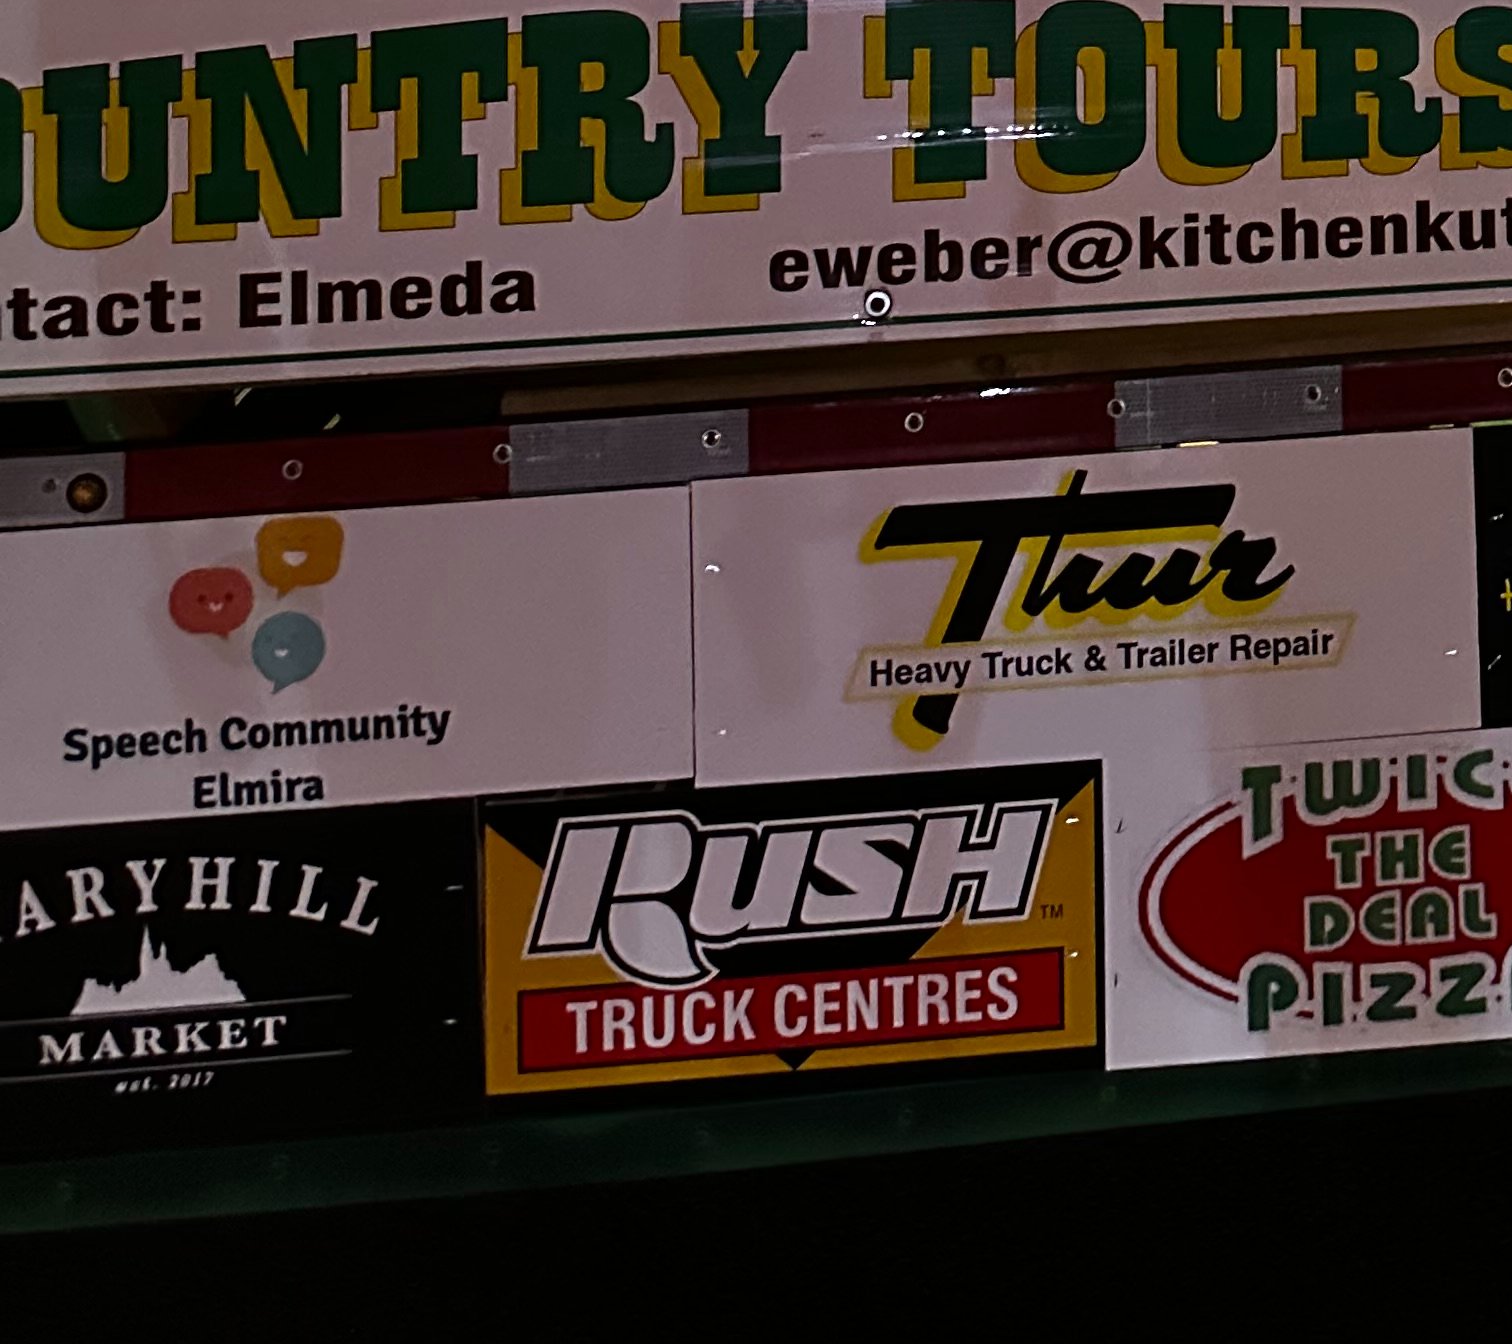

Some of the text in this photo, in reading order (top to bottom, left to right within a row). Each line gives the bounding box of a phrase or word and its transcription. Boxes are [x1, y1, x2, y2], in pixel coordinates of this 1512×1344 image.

[0, 0, 808, 250] UNTRY
[0, 261, 536, 341] tact: Elmeda
[857, 469, 1295, 752] Thur
[869, 629, 1335, 689] Heavy Truck & Trailer Repair
[63, 704, 451, 769] Speech Community
[193, 769, 325, 809] Elmira
[1327, 824, 1471, 890] THE
[0, 856, 381, 944] ARYHILL
[521, 798, 1059, 989] RUSH
[1304, 883, 1497, 954] DEAL
[37, 1015, 288, 1065] MARKET
[566, 966, 1019, 1054] TRUCK CENTRES
[168, 1071, 216, 1090] 2017
